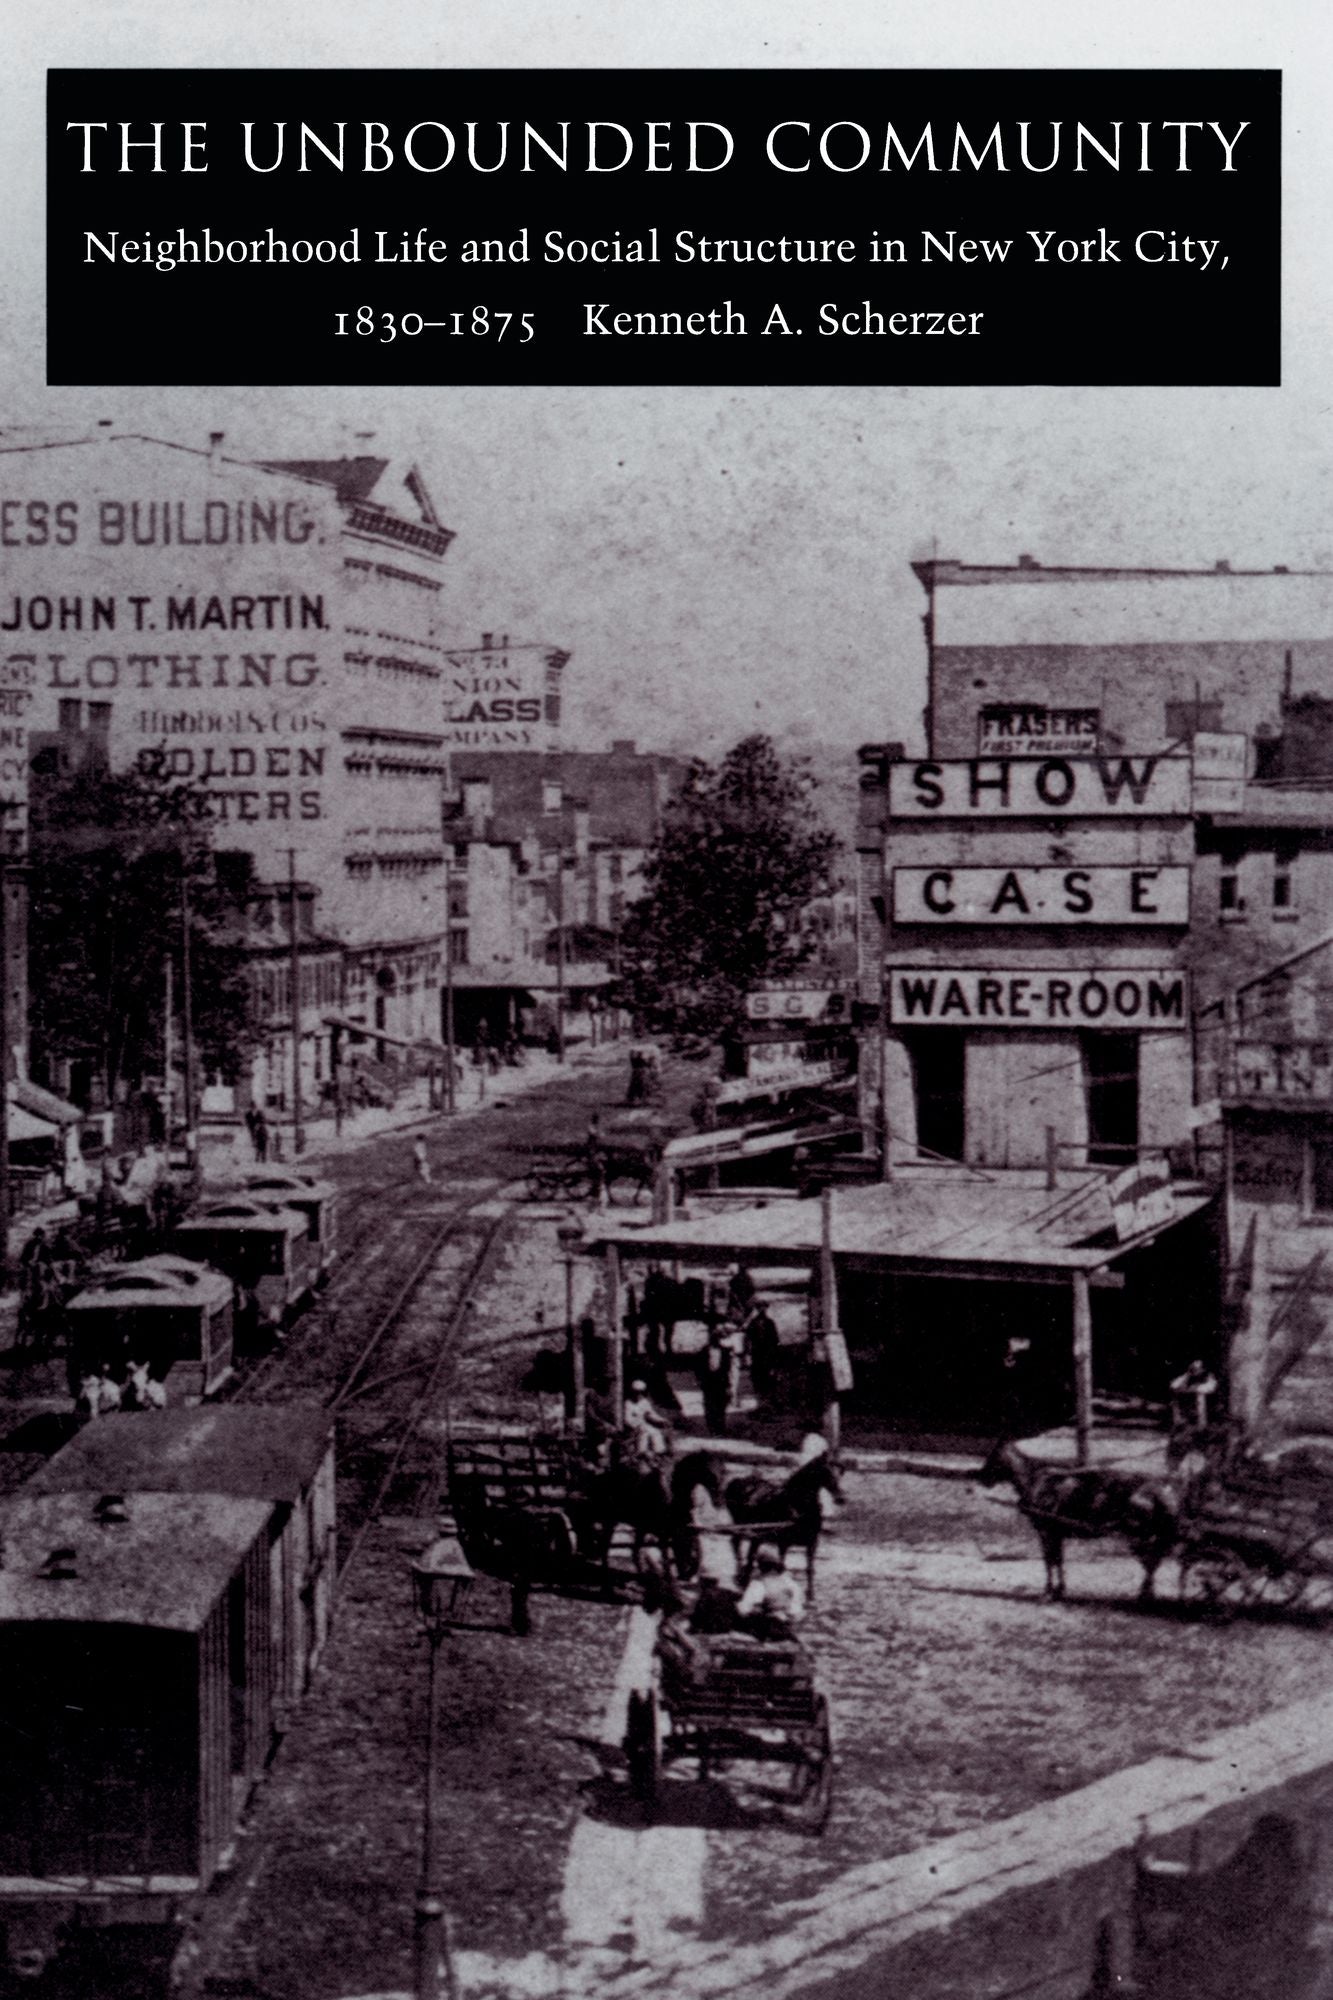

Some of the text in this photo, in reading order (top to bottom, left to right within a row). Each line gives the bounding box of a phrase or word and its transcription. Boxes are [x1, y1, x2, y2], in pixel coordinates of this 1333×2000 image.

[0, 501, 79, 546] ESS
[0, 597, 116, 631] JOHN
[127, 596, 157, 631] T.
[912, 759, 1160, 808] SHOW
[922, 871, 1159, 914] CASE
[900, 978, 1184, 1019] WARE-ROOM
